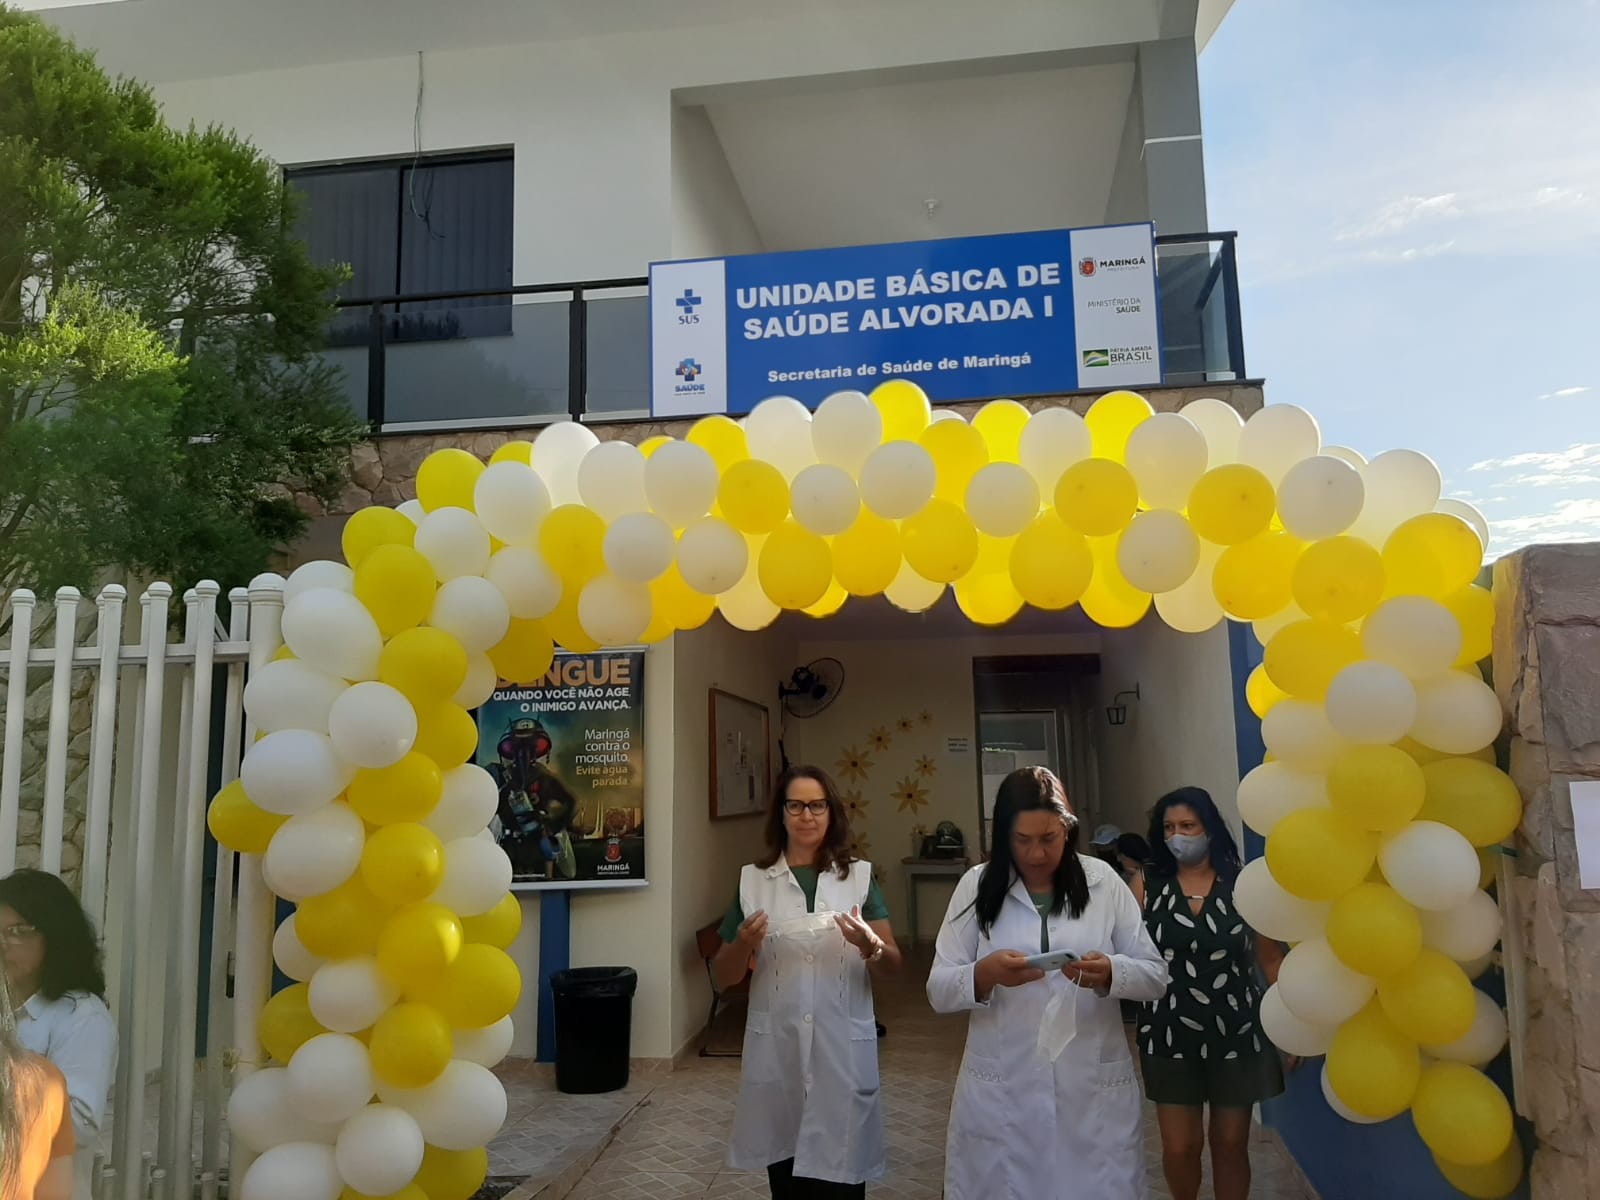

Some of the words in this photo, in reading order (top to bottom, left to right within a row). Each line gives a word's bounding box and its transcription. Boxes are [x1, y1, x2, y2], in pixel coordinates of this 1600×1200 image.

[1100, 256, 1146, 268] MARINGÁ
[736, 278, 876, 309] UNIDADE
[886, 268, 1008, 297] BÁSICA
[1017, 263, 1060, 287] DE
[1088, 298, 1129, 308] MINISTÉRIO
[1130, 297, 1140, 305] DA
[678, 314, 700, 325] SUS
[744, 310, 849, 340] SAÚDE
[859, 298, 1034, 331] ALVORADA
[1044, 295, 1053, 317] I
[1110, 351, 1152, 362] BRASIL
[768, 366, 852, 383] Secretaria
[857, 363, 877, 377] de
[882, 359, 933, 375] Saúde
[938, 357, 958, 370] de
[963, 351, 1032, 369] Maringá
[675, 384, 705, 393] SAÚDE
[493, 690, 543, 701] QUANDO
[545, 687, 577, 699] VOCÊ
[578, 686, 604, 698] NÃO
[520, 703, 530, 713] O
[532, 701, 577, 712] INIMIGO
[578, 699, 631, 711] AVANÇA.
[584, 728, 630, 742] Maringá
[585, 741, 620, 752] contra
[622, 742, 630, 750] o
[576, 765, 601, 775] Evite
[597, 863, 630, 872] MARINGÁ
